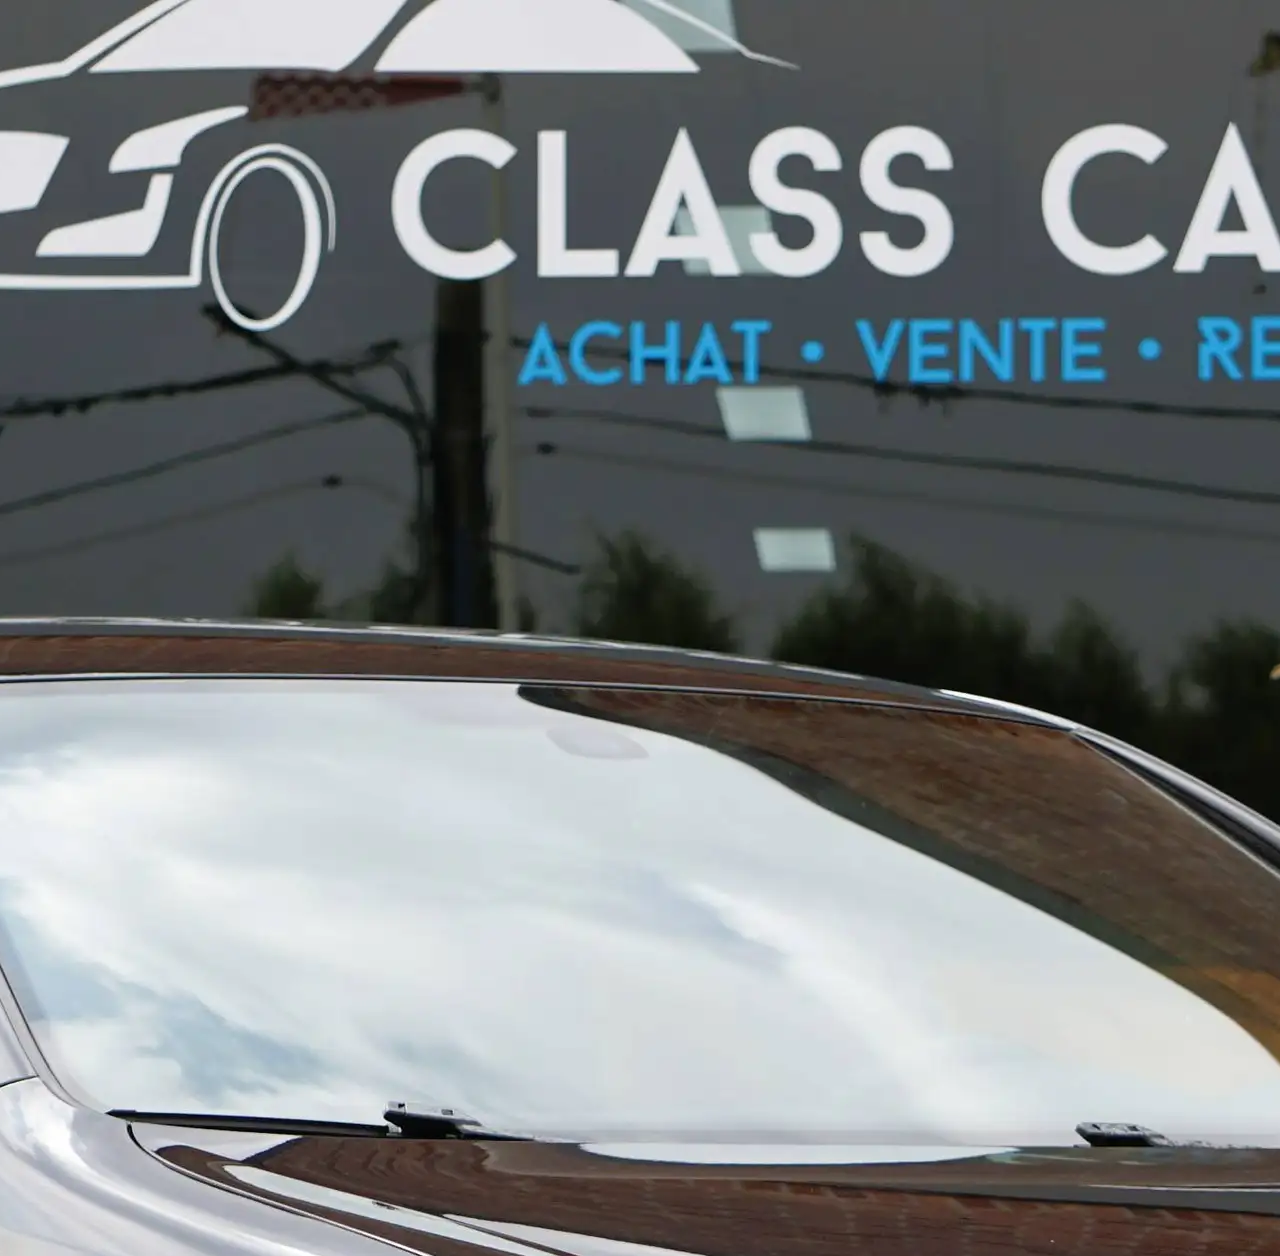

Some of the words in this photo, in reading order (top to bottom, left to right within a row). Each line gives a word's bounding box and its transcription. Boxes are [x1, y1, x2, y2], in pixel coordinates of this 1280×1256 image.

[391, 126, 954, 280] CLASS
[518, 319, 772, 386] ACHAT
[855, 317, 1107, 383] VENTE
